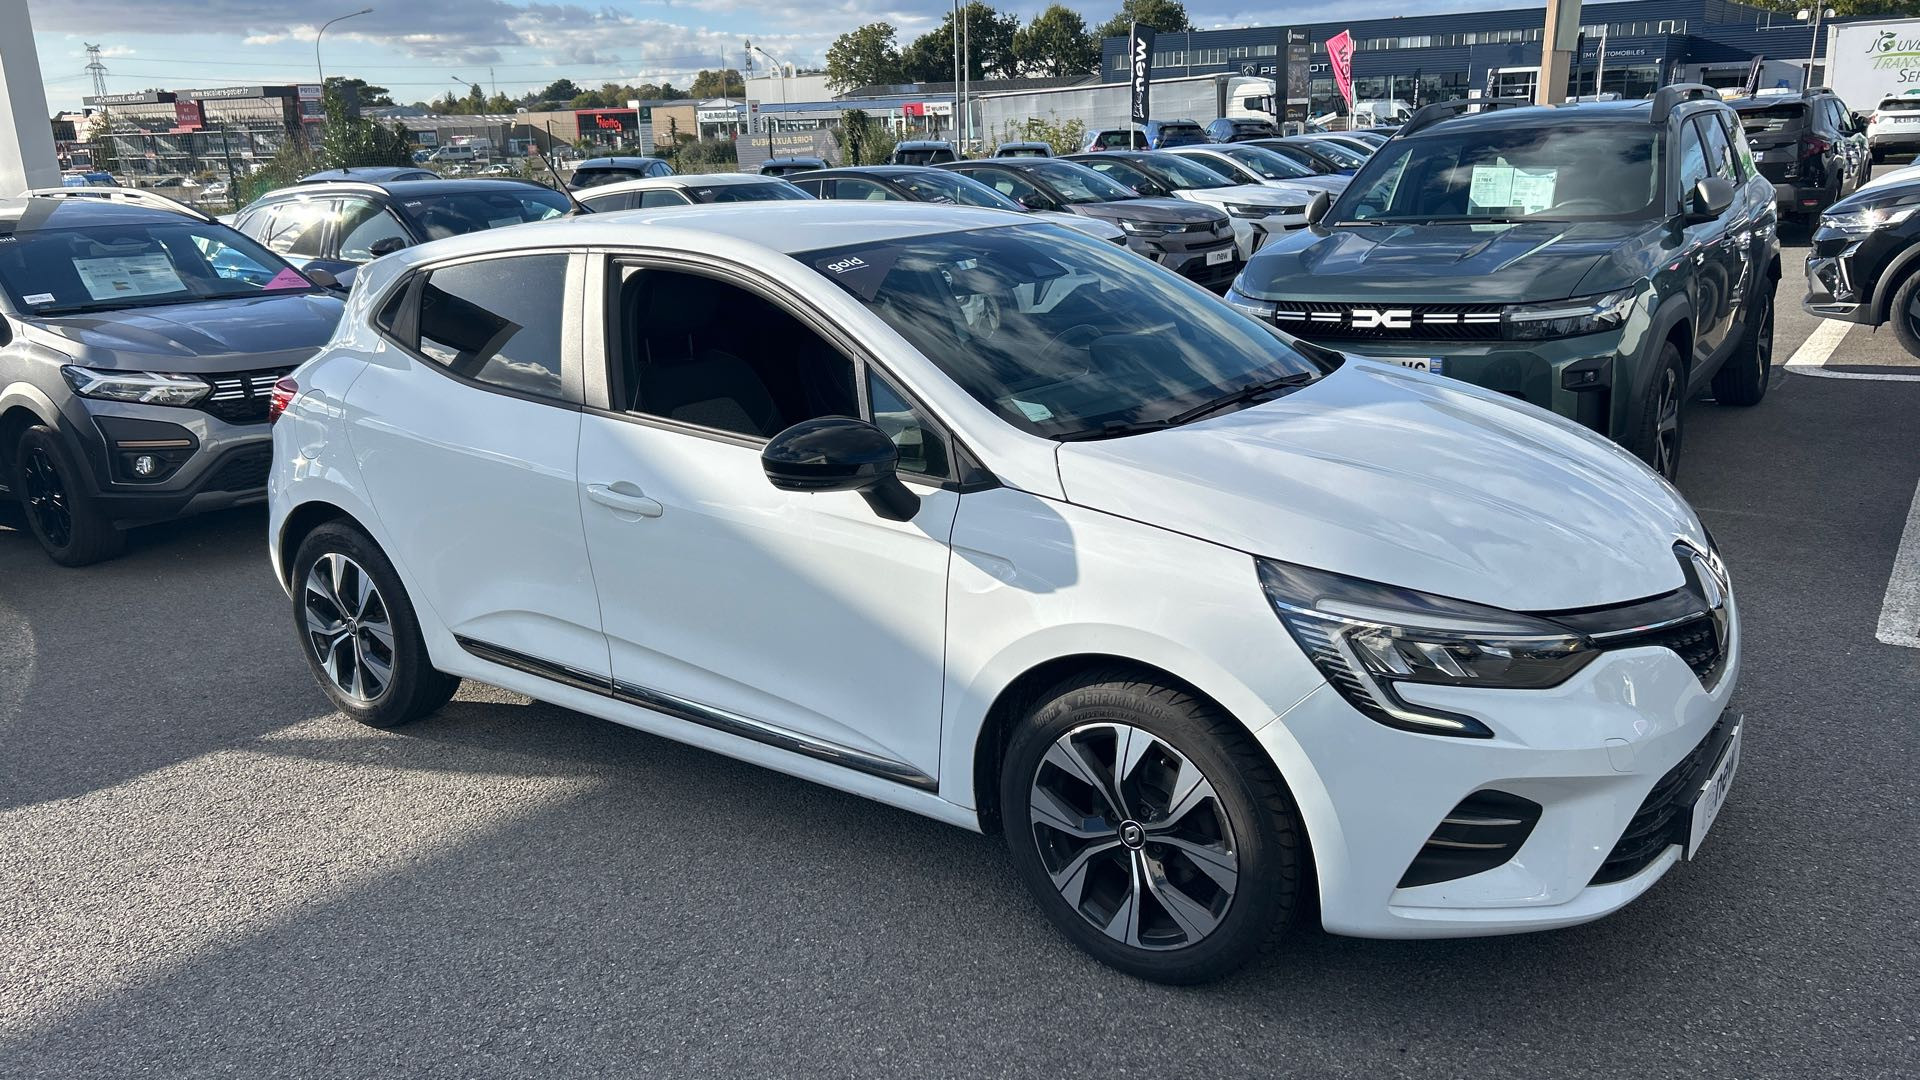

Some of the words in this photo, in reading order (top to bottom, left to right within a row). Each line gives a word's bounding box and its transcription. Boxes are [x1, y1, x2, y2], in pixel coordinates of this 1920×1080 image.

[1602, 49, 1646, 58] UTOMOBILES
[1260, 63, 1328, 75] PEOT
[598, 118, 619, 129] Netto
[827, 256, 865, 273] gold
[1076, 692, 1176, 721] PERFORMANCE
